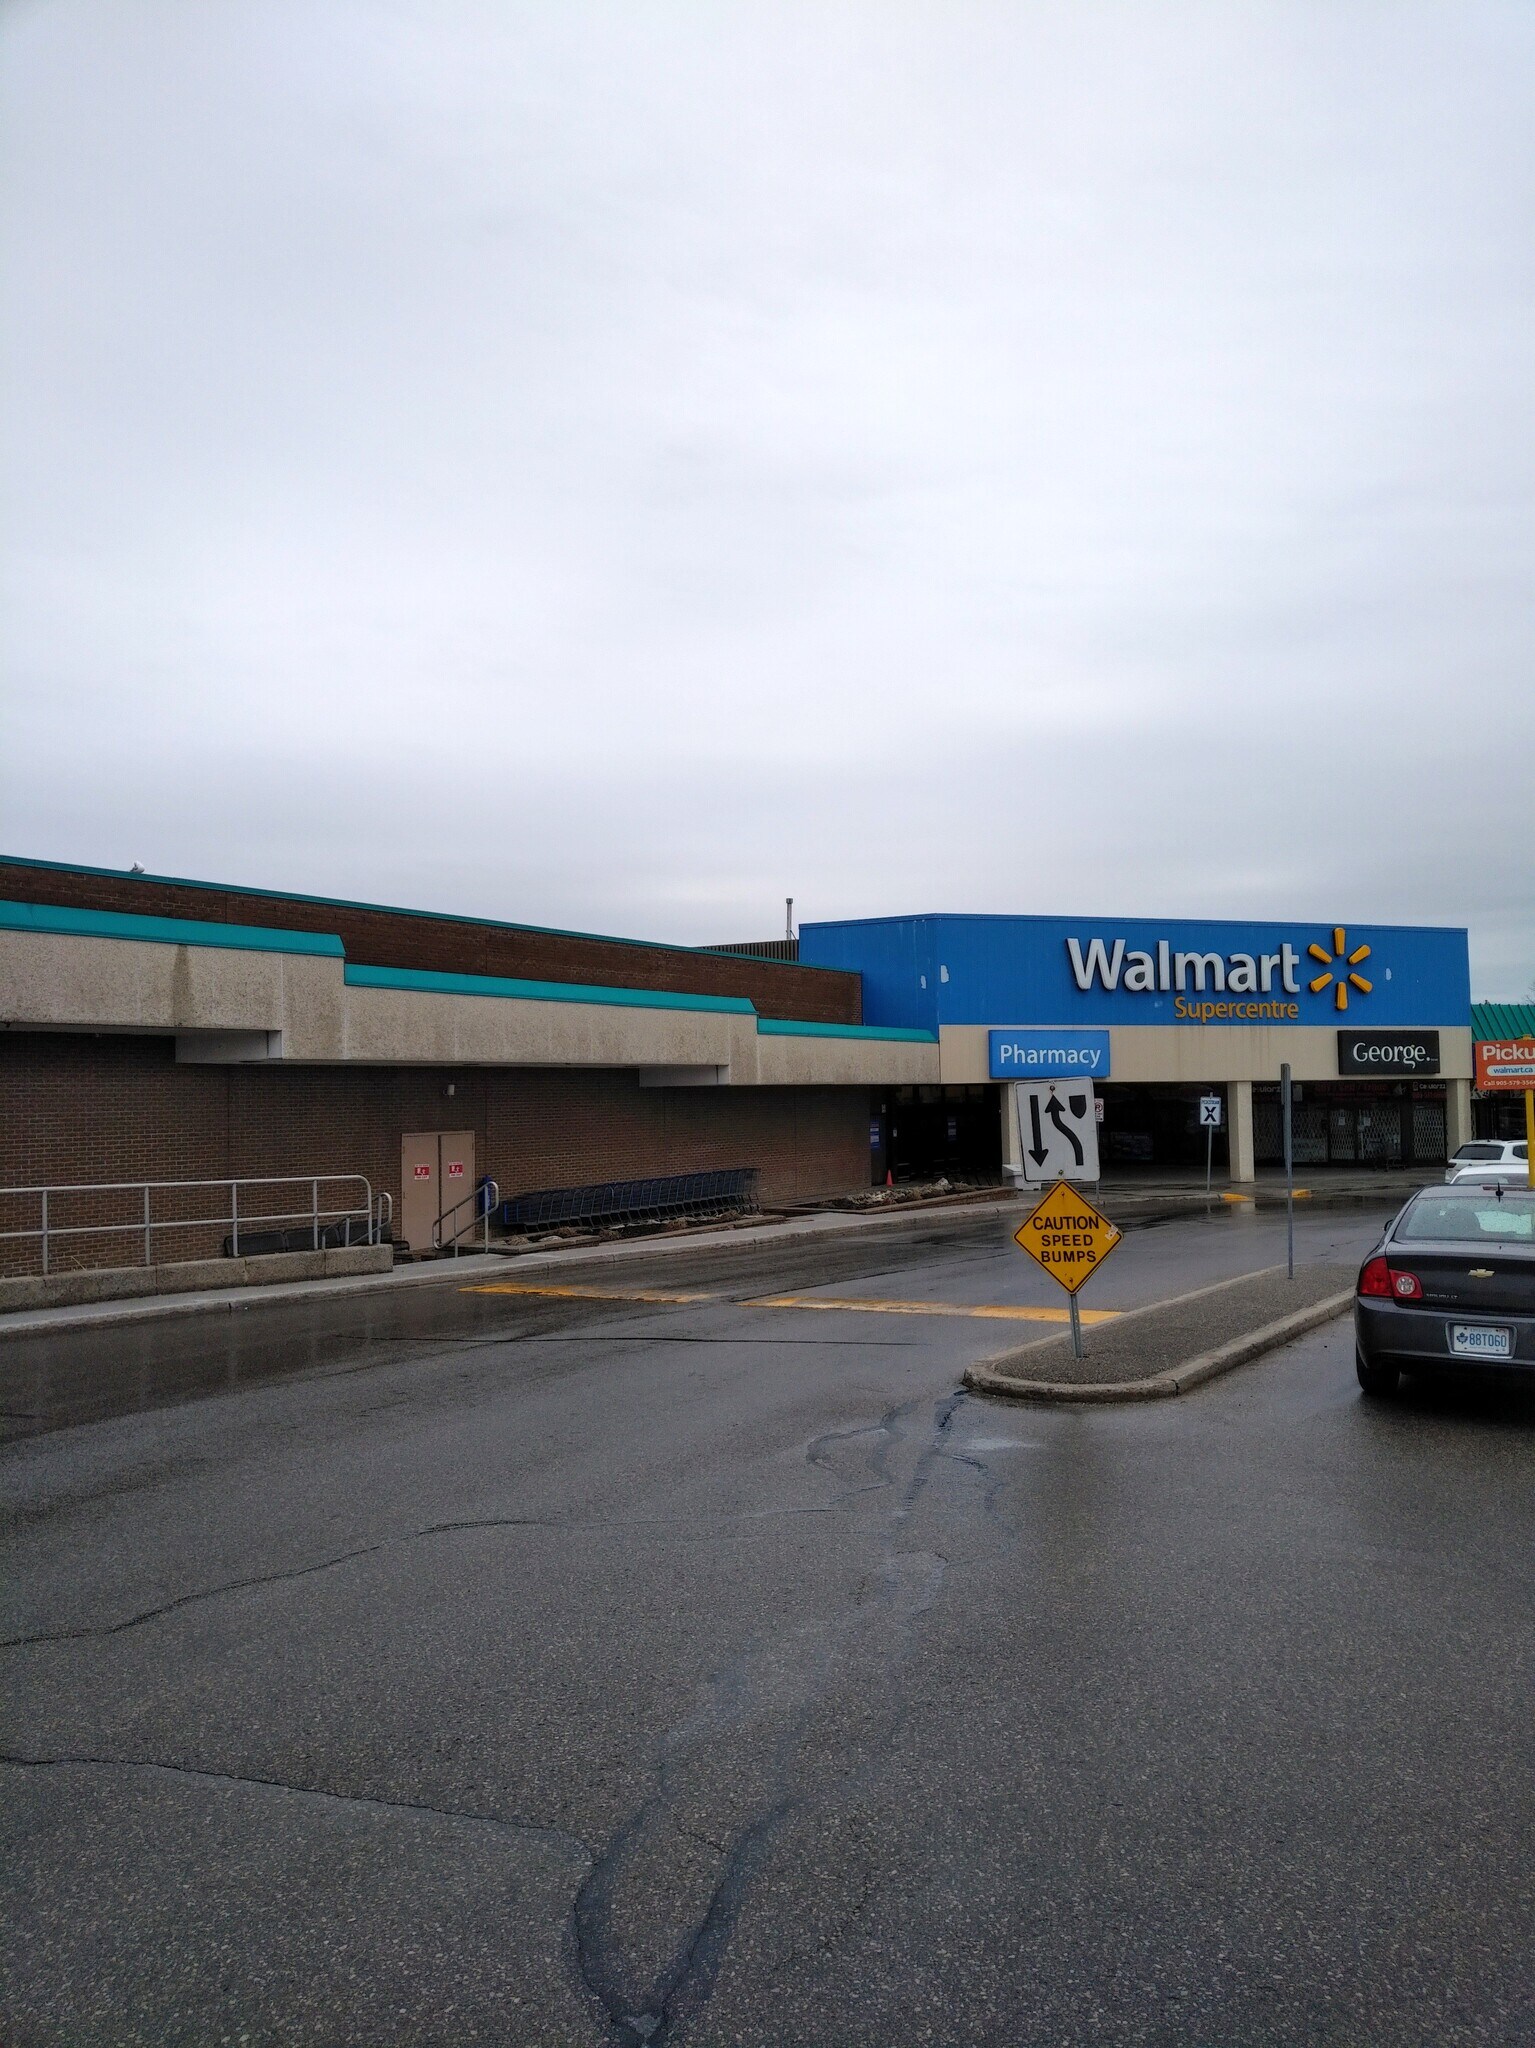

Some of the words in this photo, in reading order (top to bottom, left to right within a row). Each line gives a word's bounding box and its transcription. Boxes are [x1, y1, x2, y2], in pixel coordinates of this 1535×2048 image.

[1066, 937, 1301, 994] Walmart
[1174, 996, 1299, 1023] Supercentre
[1000, 1043, 1102, 1069] Pharmacy
[1493, 1066, 1534, 1074] walmart.ca
[1033, 1216, 1099, 1230] CAUTION
[1041, 1235, 1093, 1246] SPEED
[1041, 1251, 1096, 1262] BUMPS
